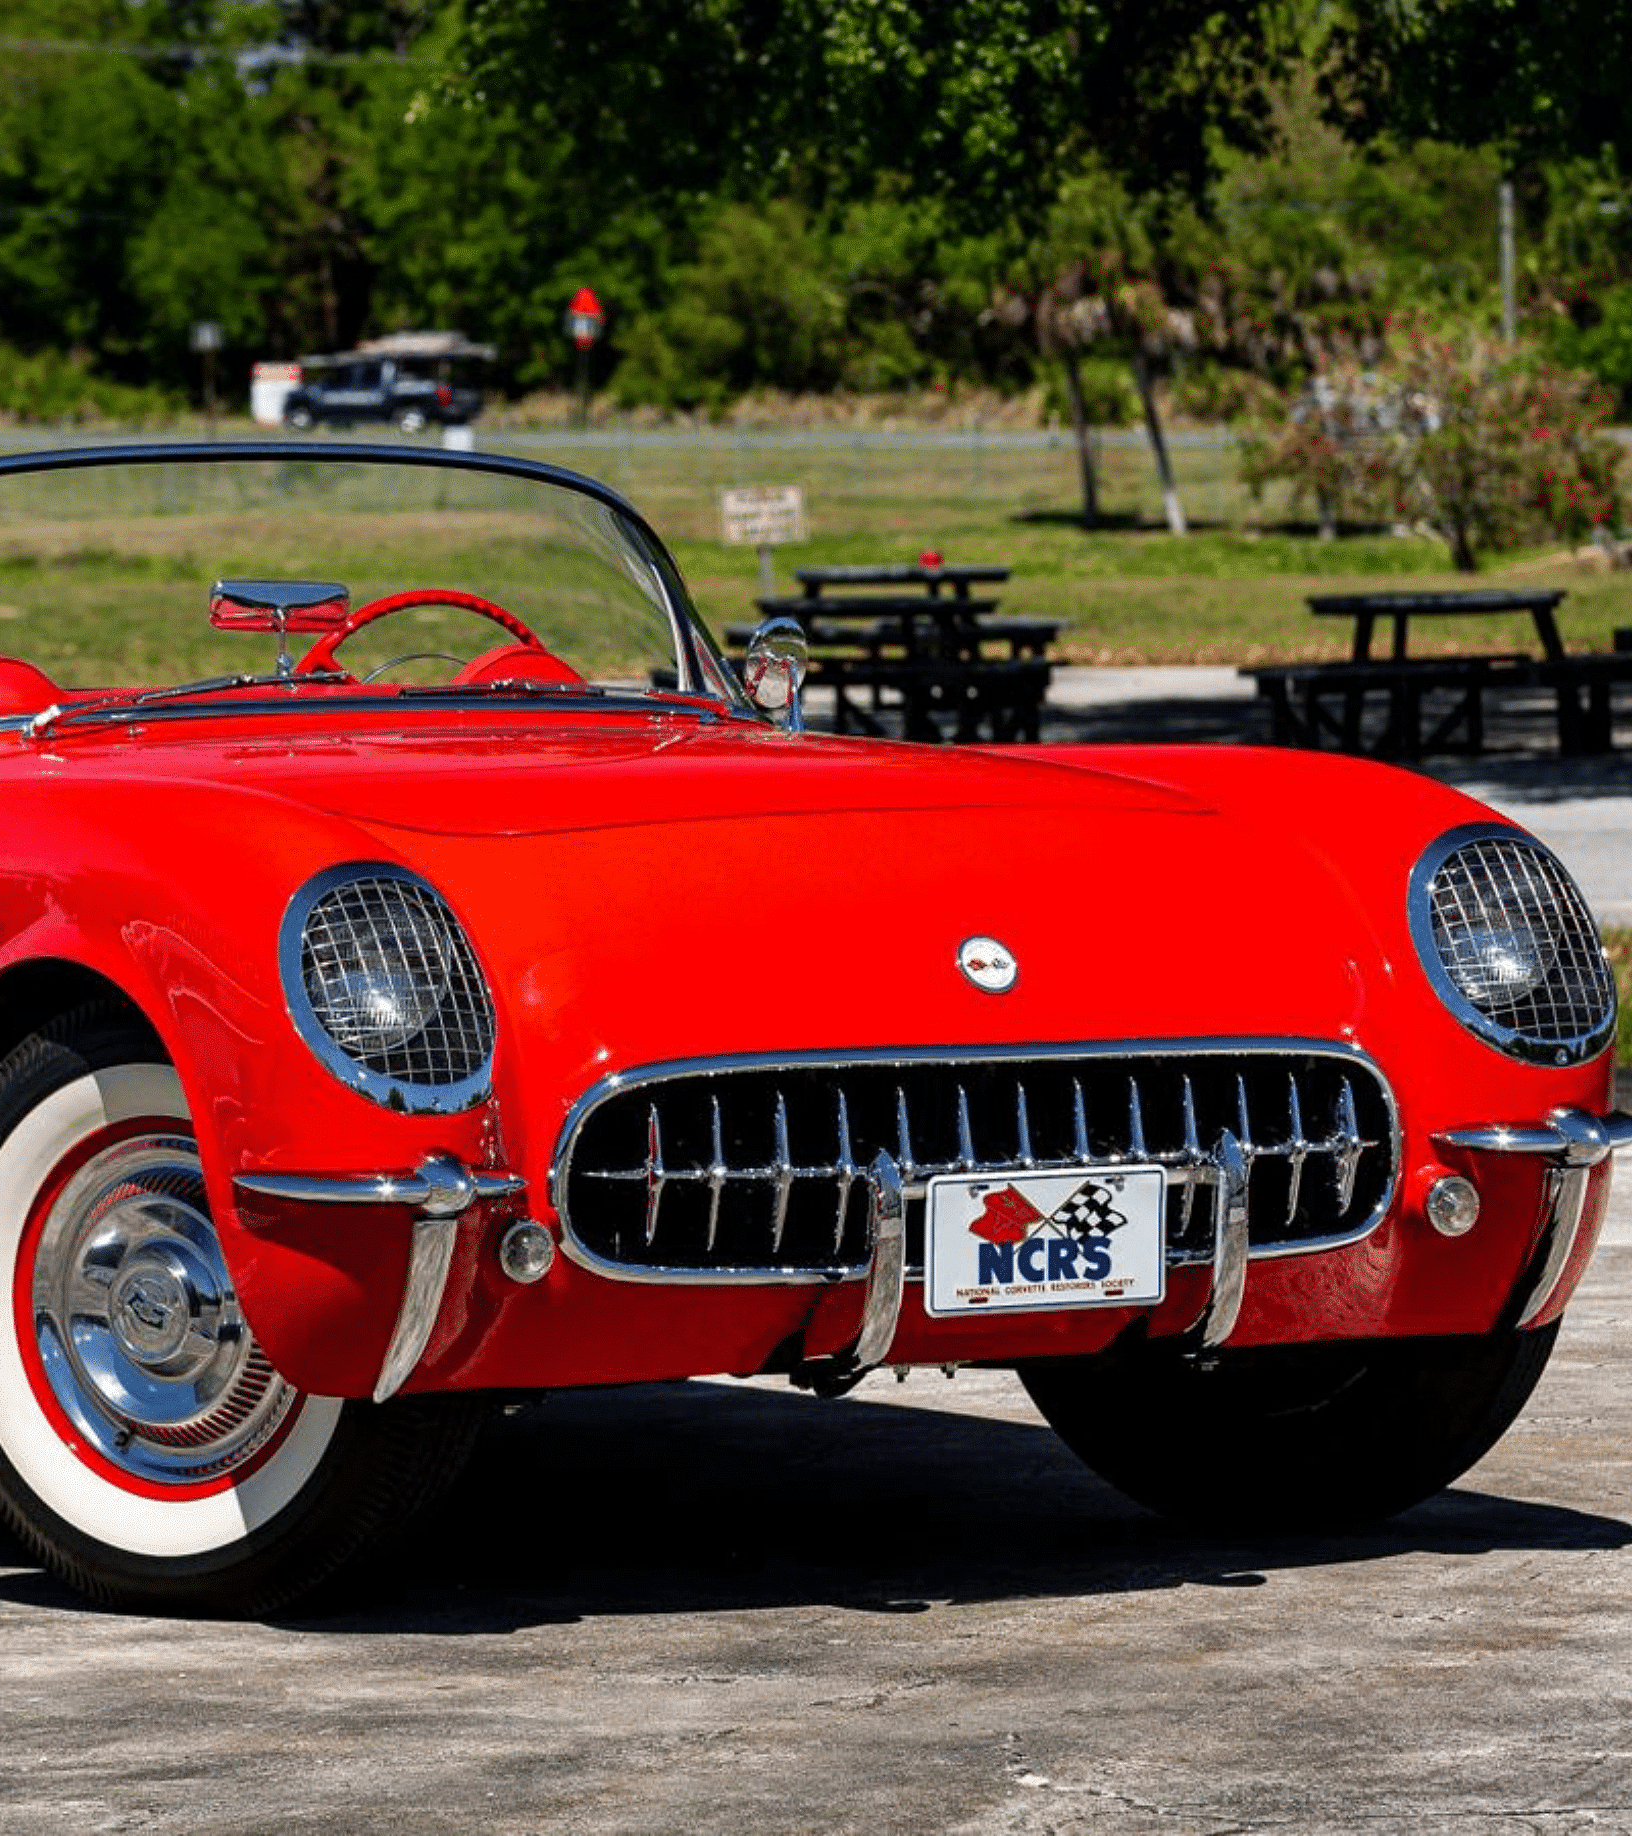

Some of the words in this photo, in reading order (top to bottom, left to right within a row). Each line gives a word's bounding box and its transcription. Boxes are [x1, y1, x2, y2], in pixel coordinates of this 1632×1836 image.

[979, 1236, 1112, 1285] NCRS
[956, 1286, 1000, 1297] NATIONAL
[1005, 1283, 1046, 1295] CORVETTE
[1101, 1277, 1135, 1288] SOCIETY
